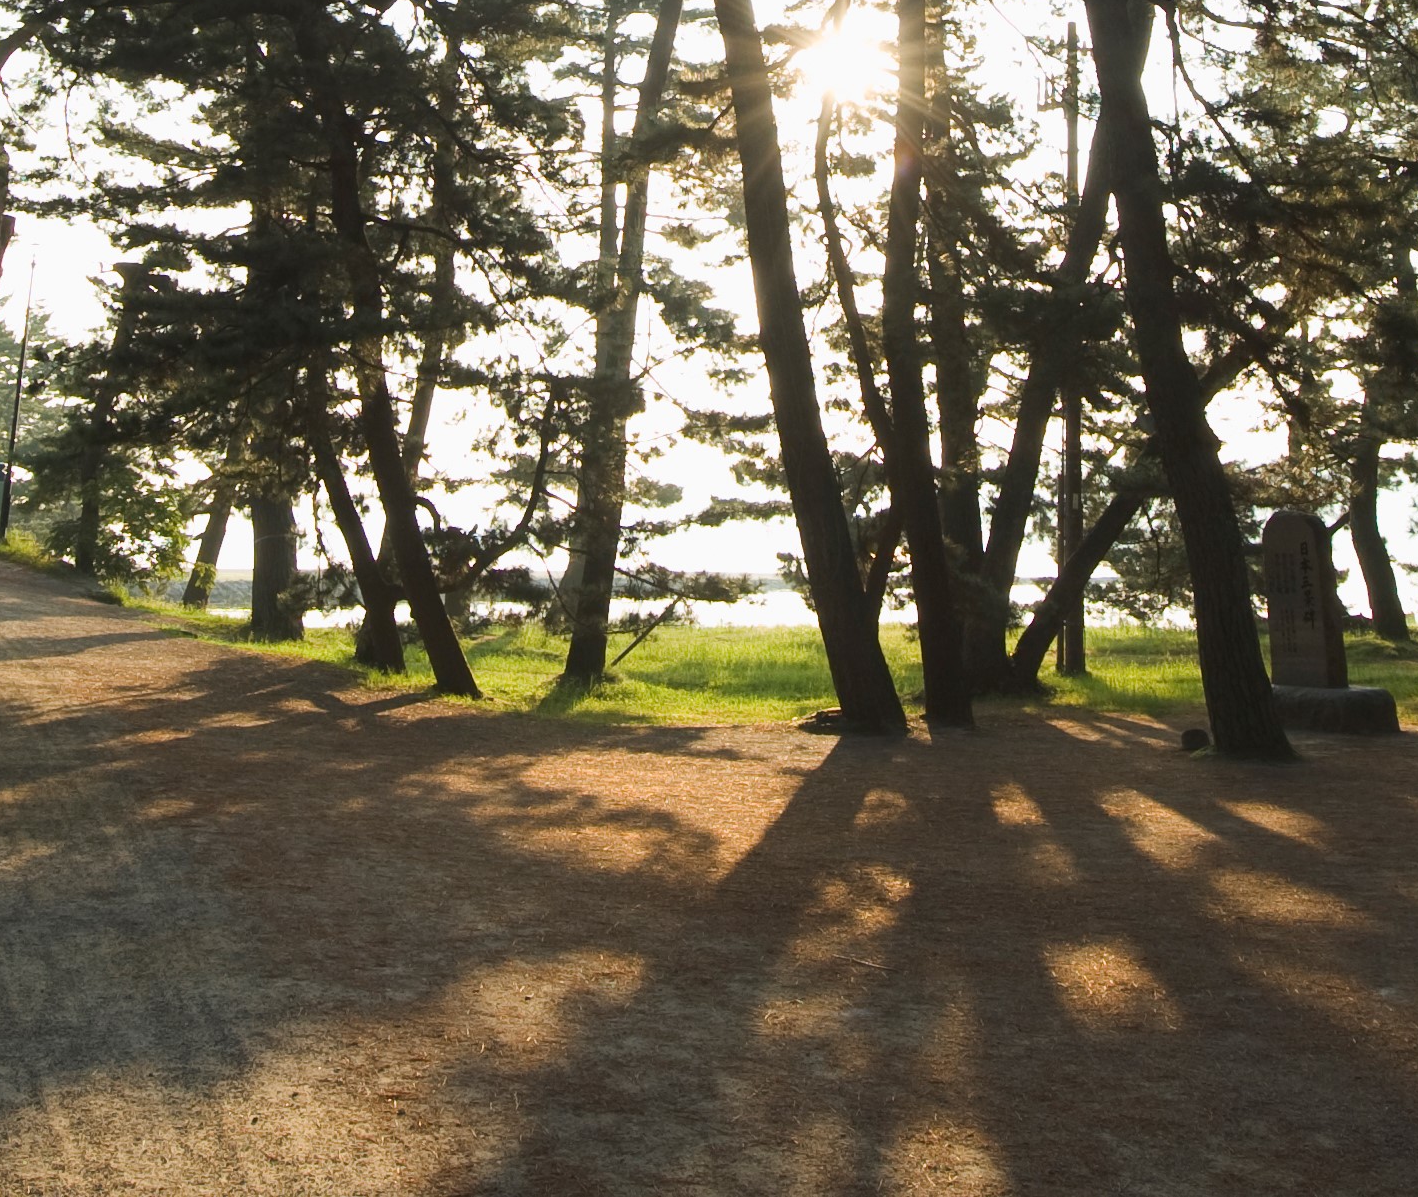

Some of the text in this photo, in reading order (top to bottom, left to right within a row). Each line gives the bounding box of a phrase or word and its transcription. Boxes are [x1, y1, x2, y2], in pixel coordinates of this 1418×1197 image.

[1300, 541, 1315, 630] 日本三景碑
